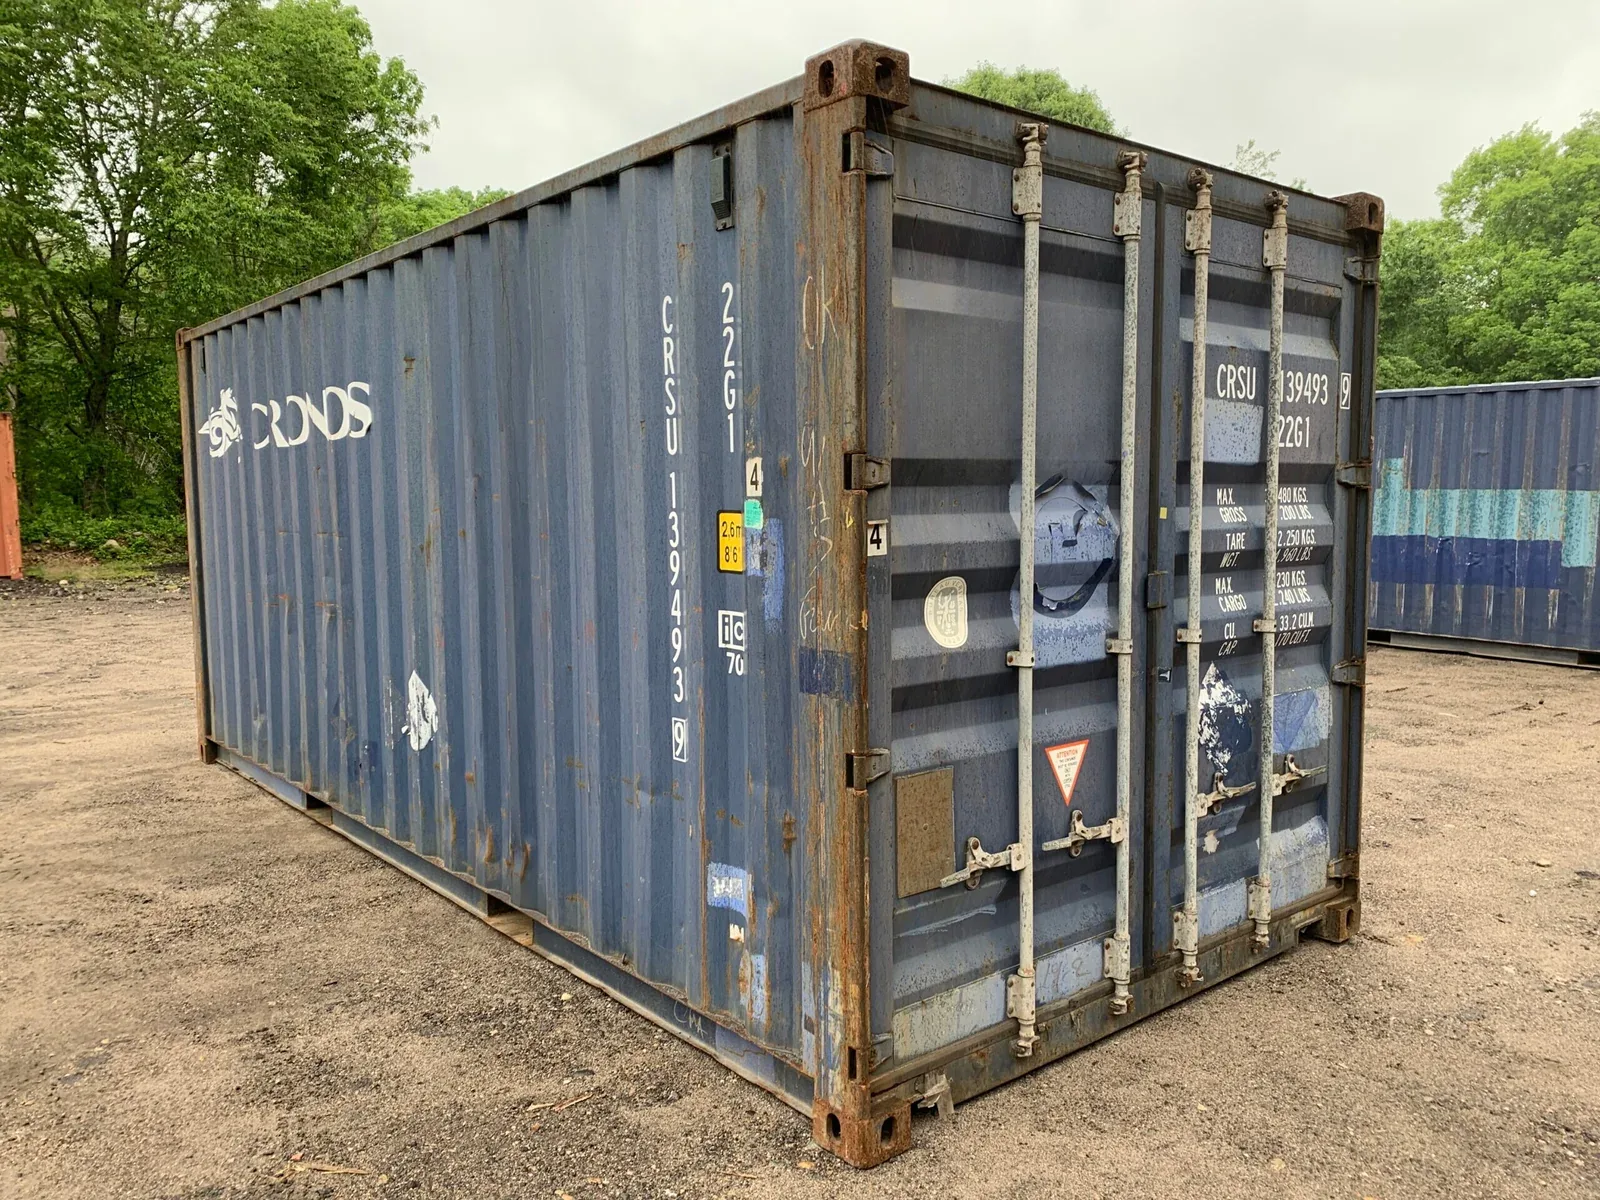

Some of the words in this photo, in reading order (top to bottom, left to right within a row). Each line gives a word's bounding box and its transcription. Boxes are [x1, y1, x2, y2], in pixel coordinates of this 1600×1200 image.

[662, 295, 678, 456] CRSU
[721, 282, 736, 453] 22G1
[1216, 363, 1256, 400] CRSU
[1279, 370, 1328, 406] 139493
[1341, 376, 1350, 406] 9
[251, 381, 372, 450] CRONOS
[749, 462, 759, 491] 4
[1278, 487, 1291, 503] 480
[1219, 506, 1247, 523] GROSS
[869, 523, 882, 550] 4
[1226, 532, 1246, 550] TARE
[669, 471, 684, 703] 139493
[1276, 571, 1289, 587] 230
[1218, 594, 1247, 613] CARGO
[726, 651, 744, 676] 70
[673, 721, 685, 758] 9
